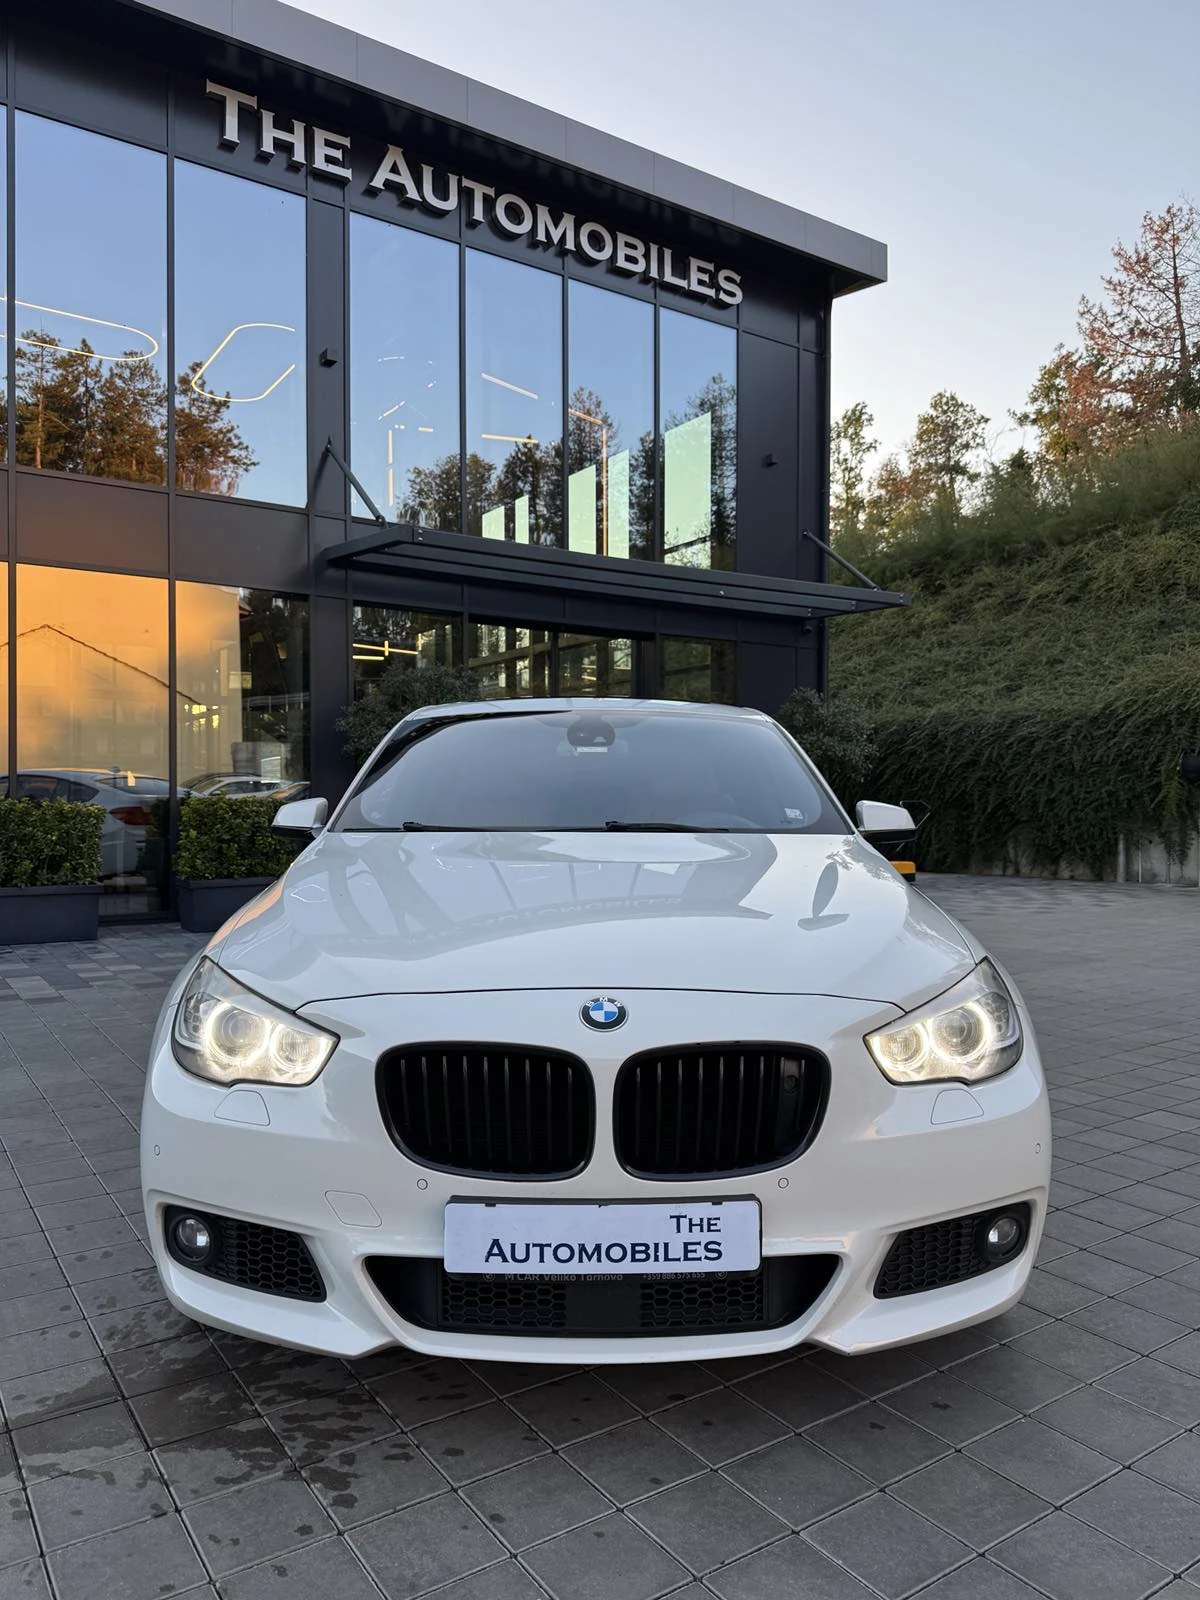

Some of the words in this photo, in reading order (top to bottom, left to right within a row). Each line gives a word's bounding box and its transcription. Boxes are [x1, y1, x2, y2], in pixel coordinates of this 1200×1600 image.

[206, 79, 352, 181] THE
[369, 144, 743, 305] AUTOMOBILES
[669, 1214, 721, 1233] THE
[485, 1238, 723, 1263] AUTOMOBILES
[517, 1273, 540, 1281] CAR
